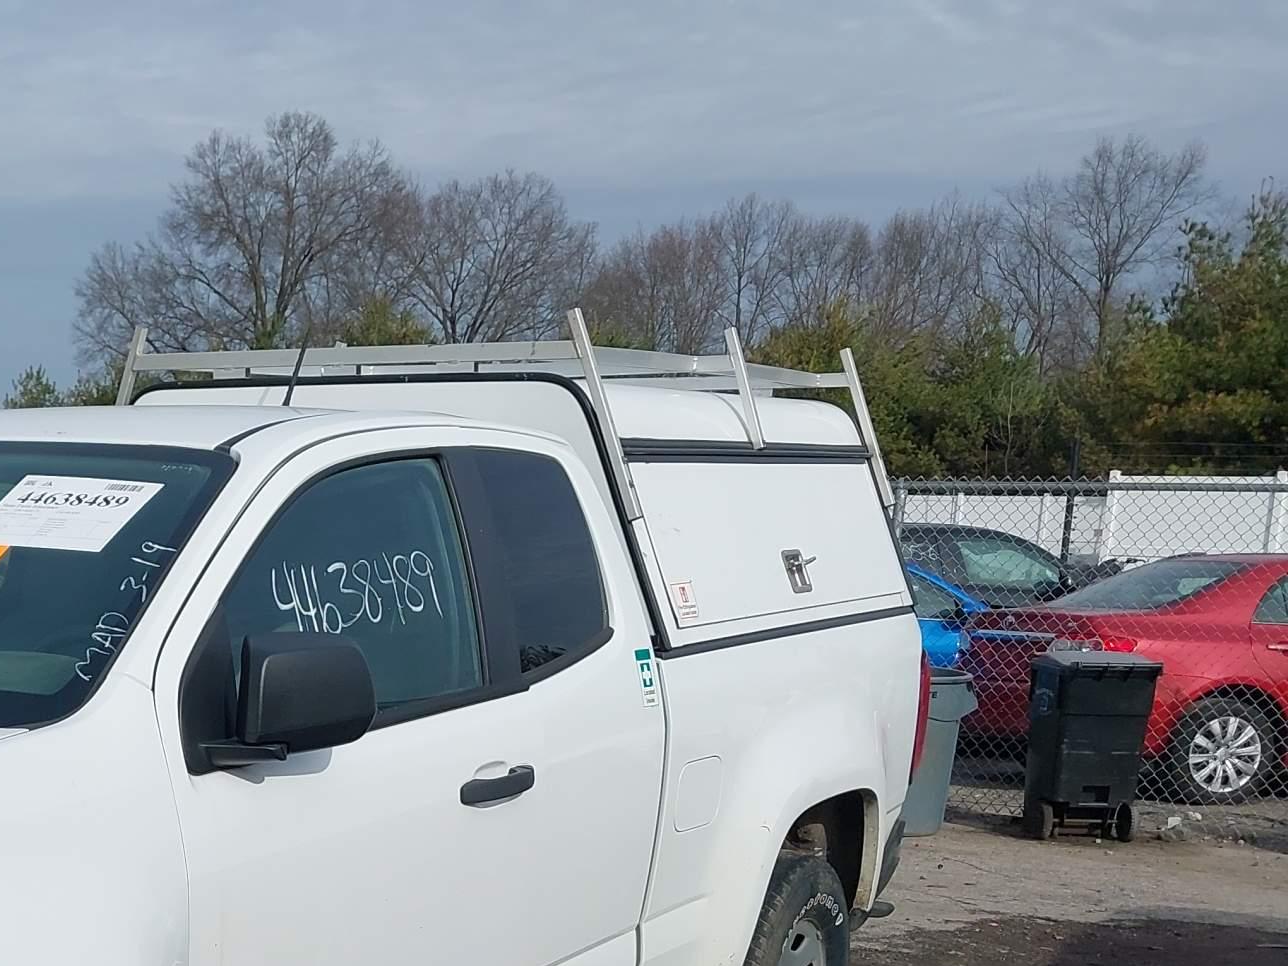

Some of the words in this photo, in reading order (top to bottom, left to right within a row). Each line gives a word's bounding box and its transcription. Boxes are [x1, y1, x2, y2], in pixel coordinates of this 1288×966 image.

[17, 491, 130, 509] 44638489
[75, 611, 129, 681] MAD
[120, 541, 178, 602] 3-19
[271, 550, 444, 635] 44638489
